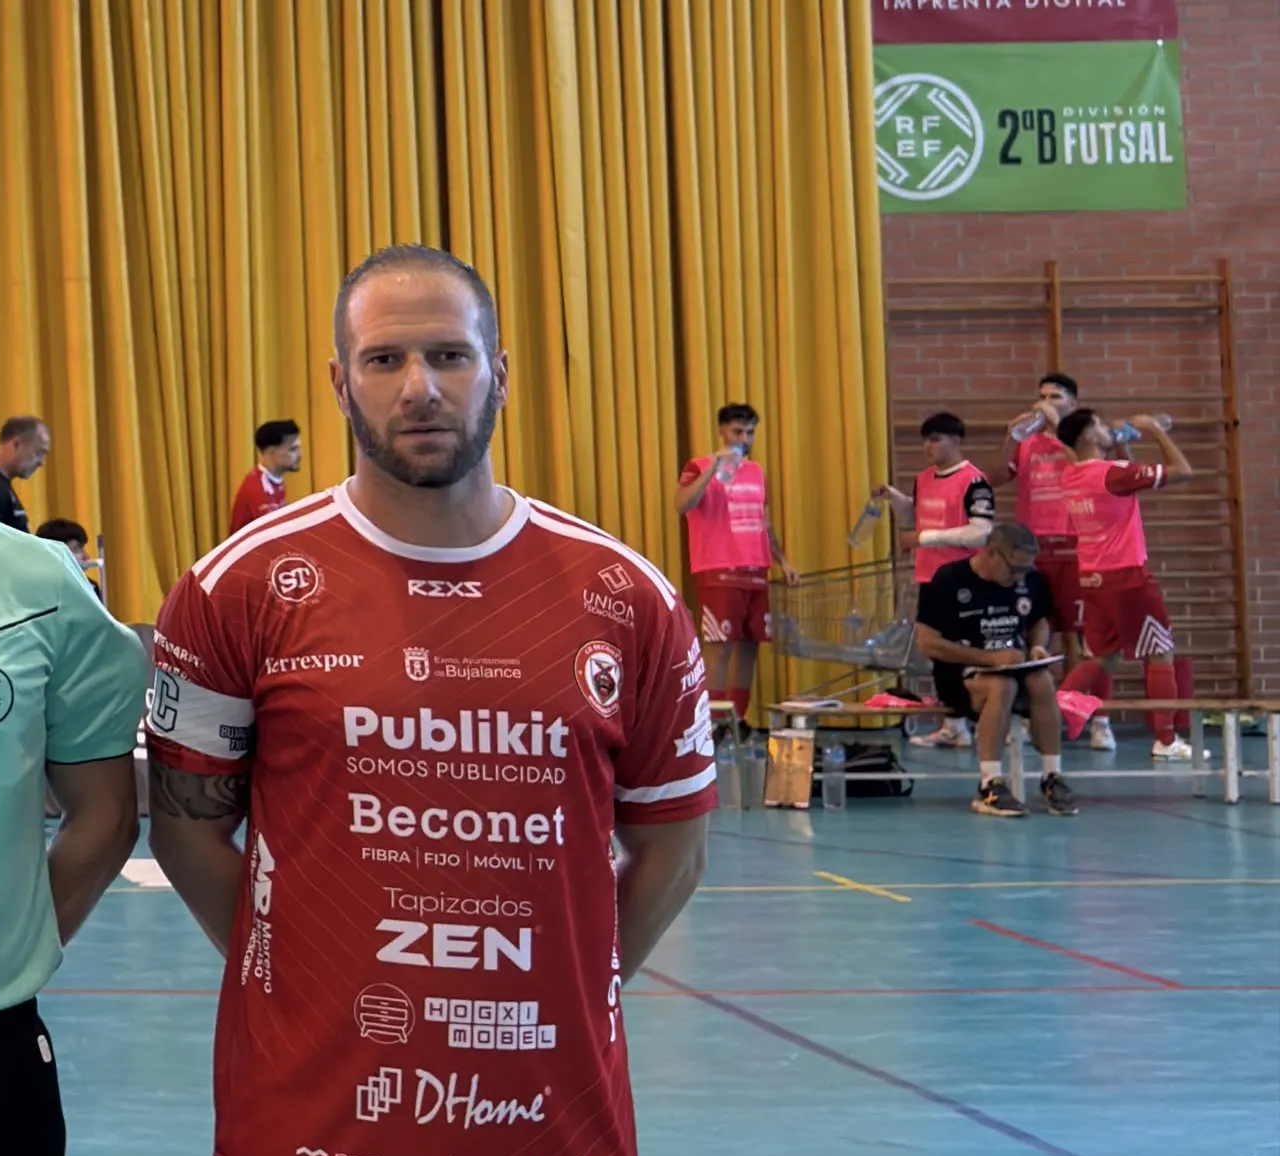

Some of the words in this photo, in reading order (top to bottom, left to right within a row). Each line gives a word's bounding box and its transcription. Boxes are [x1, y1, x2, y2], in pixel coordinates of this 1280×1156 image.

[1063, 104, 1166, 117] DIVISIÓN
[1064, 121, 1174, 165] FUTSAL
[278, 567, 311, 594] ST
[446, 665, 522, 681] Bujalance
[343, 706, 569, 758] Publikit
[346, 757, 428, 778] SOMOS
[436, 761, 566, 785] PUBLICIDAD
[348, 792, 565, 846] Beconet
[361, 847, 412, 864] FIBRA
[423, 851, 461, 867] FIJO
[473, 853, 525, 871] MÓVIL
[535, 858, 555, 871] TV
[383, 886, 534, 917] Tapizados
[261, 922, 272, 994] Moreno
[375, 919, 532, 971] ZEN
[424, 998, 538, 1023] HOGXI
[448, 1024, 556, 1049] MOBEL
[414, 1069, 545, 1130] DHome
